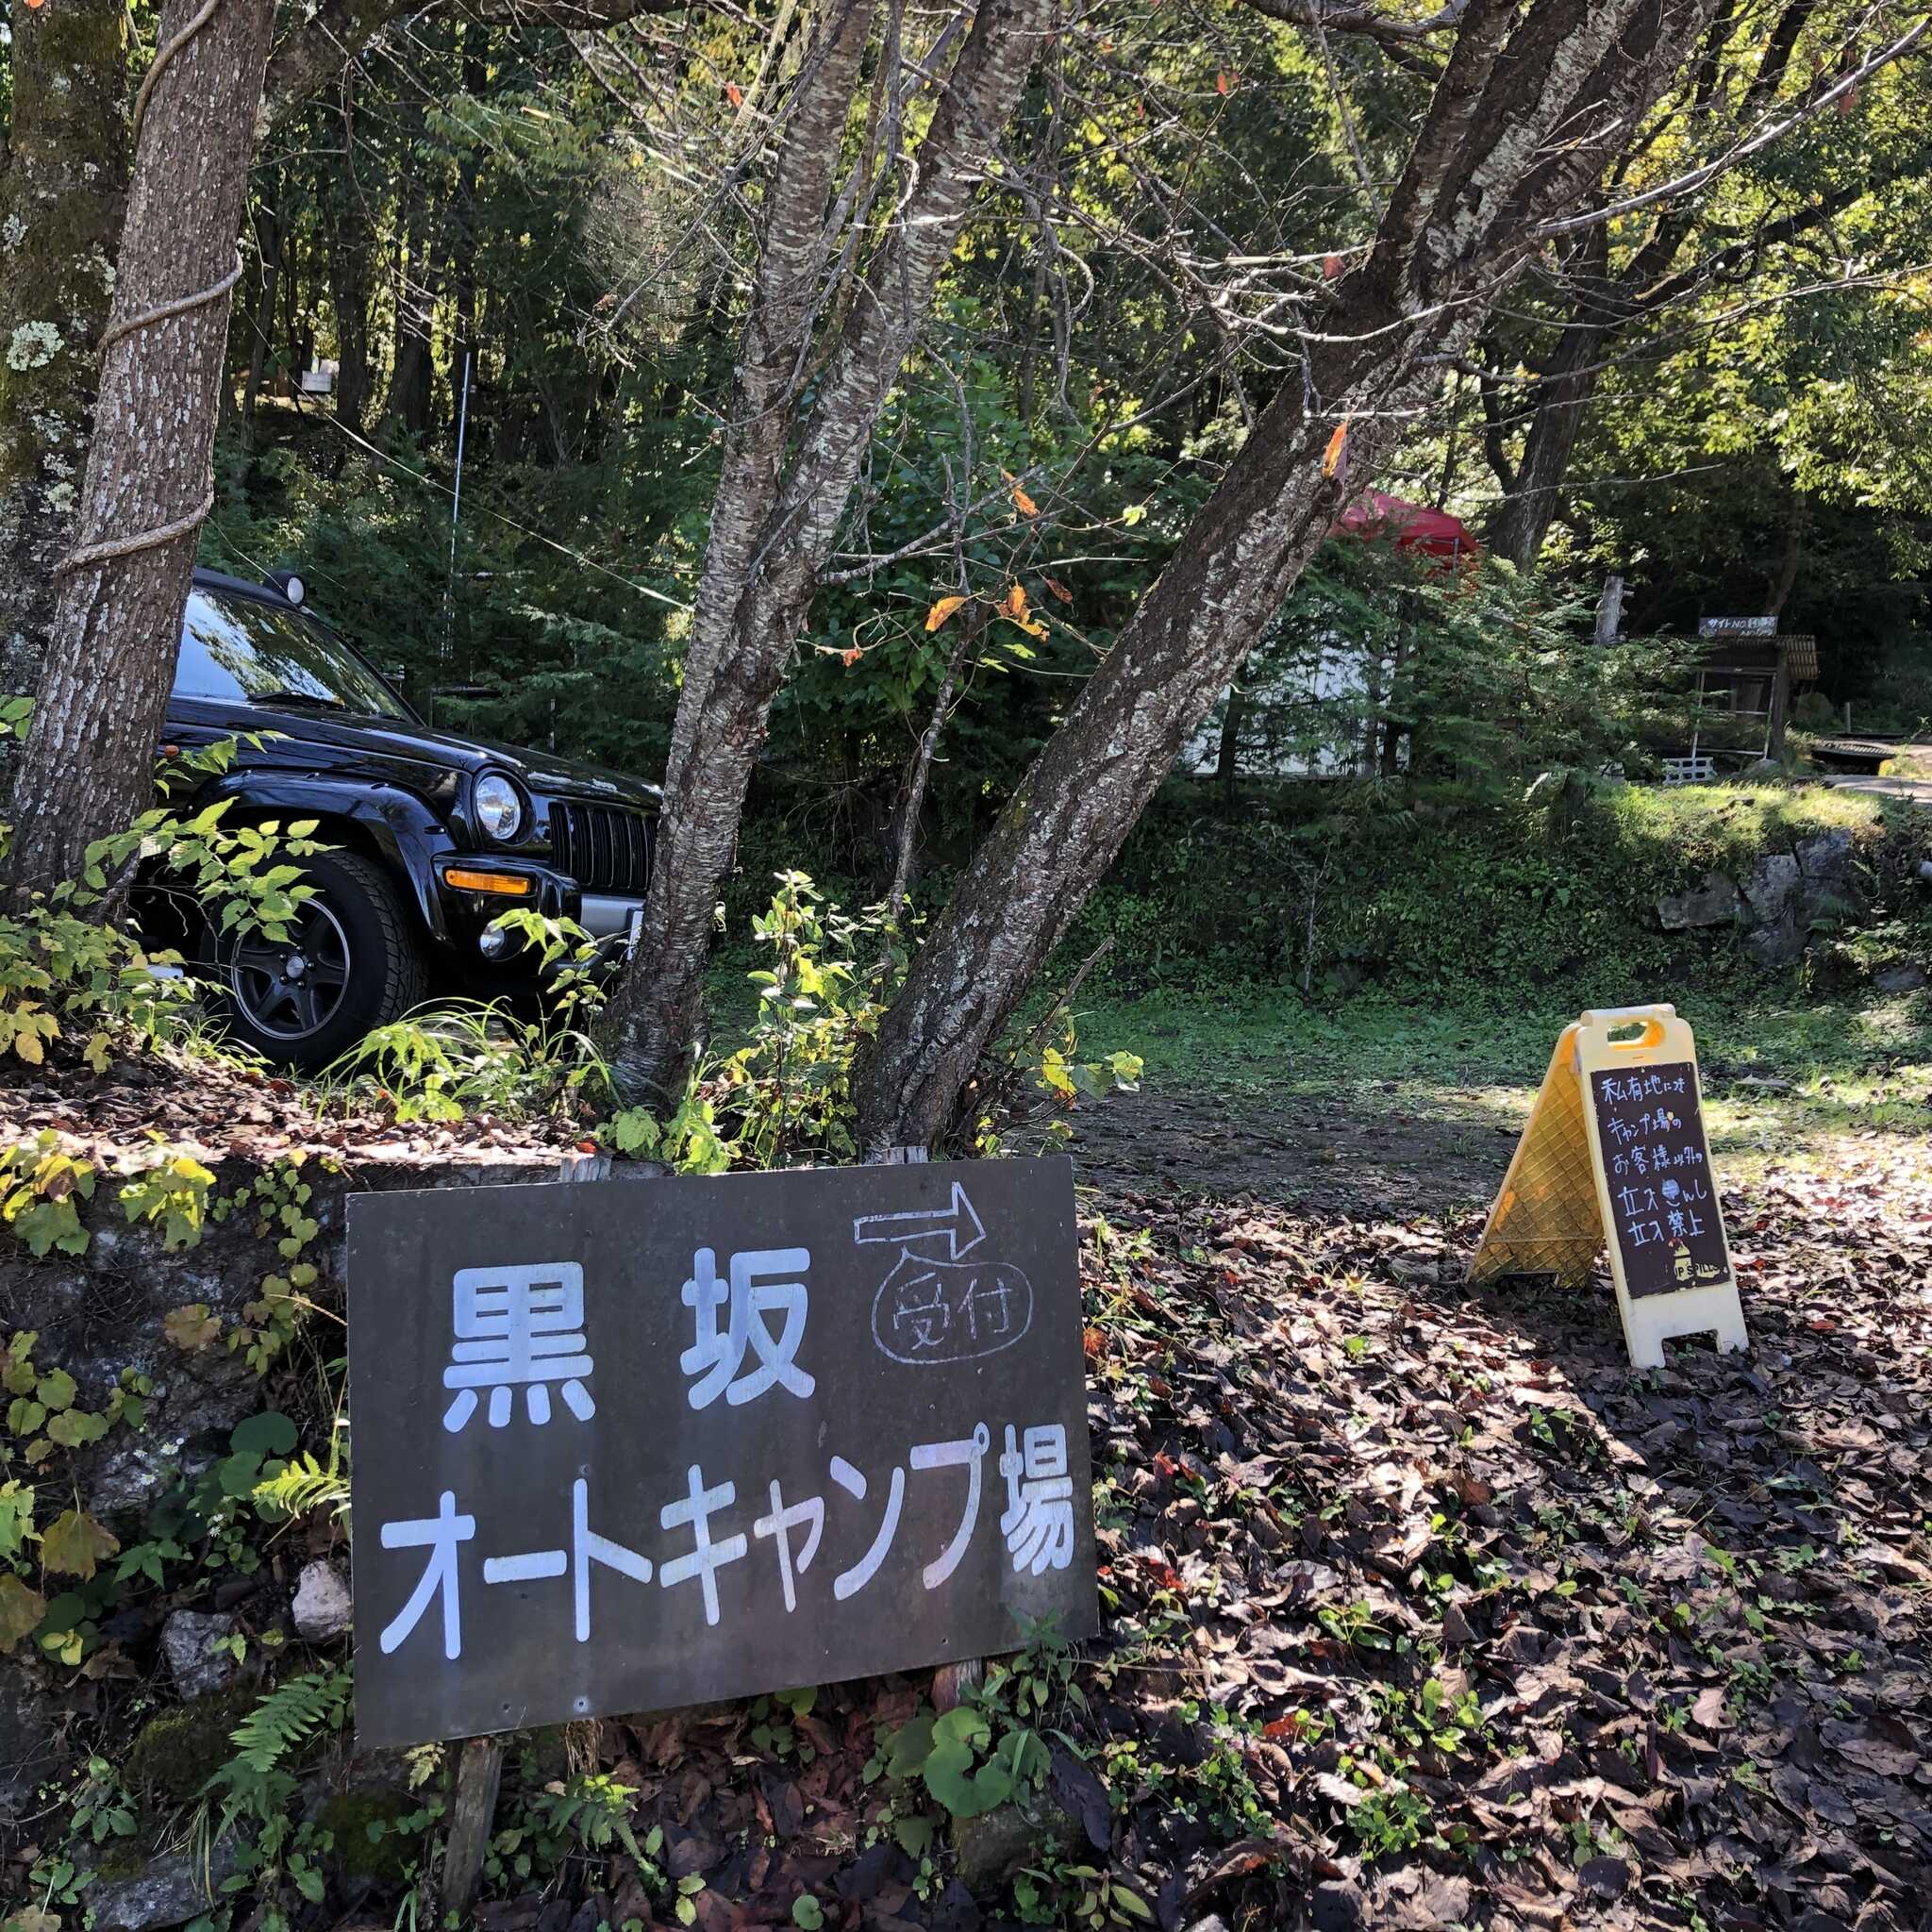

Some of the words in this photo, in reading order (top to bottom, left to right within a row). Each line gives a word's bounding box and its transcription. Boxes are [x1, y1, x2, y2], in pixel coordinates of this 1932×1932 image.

[1607, 1108, 1682, 1145] キャンプ場の
[1612, 1144, 1704, 1176] お客様以外の
[441, 1245, 817, 1434] 黒坂
[892, 1272, 1013, 1351] 受付
[379, 1421, 1075, 1661] オートキャンプ場
